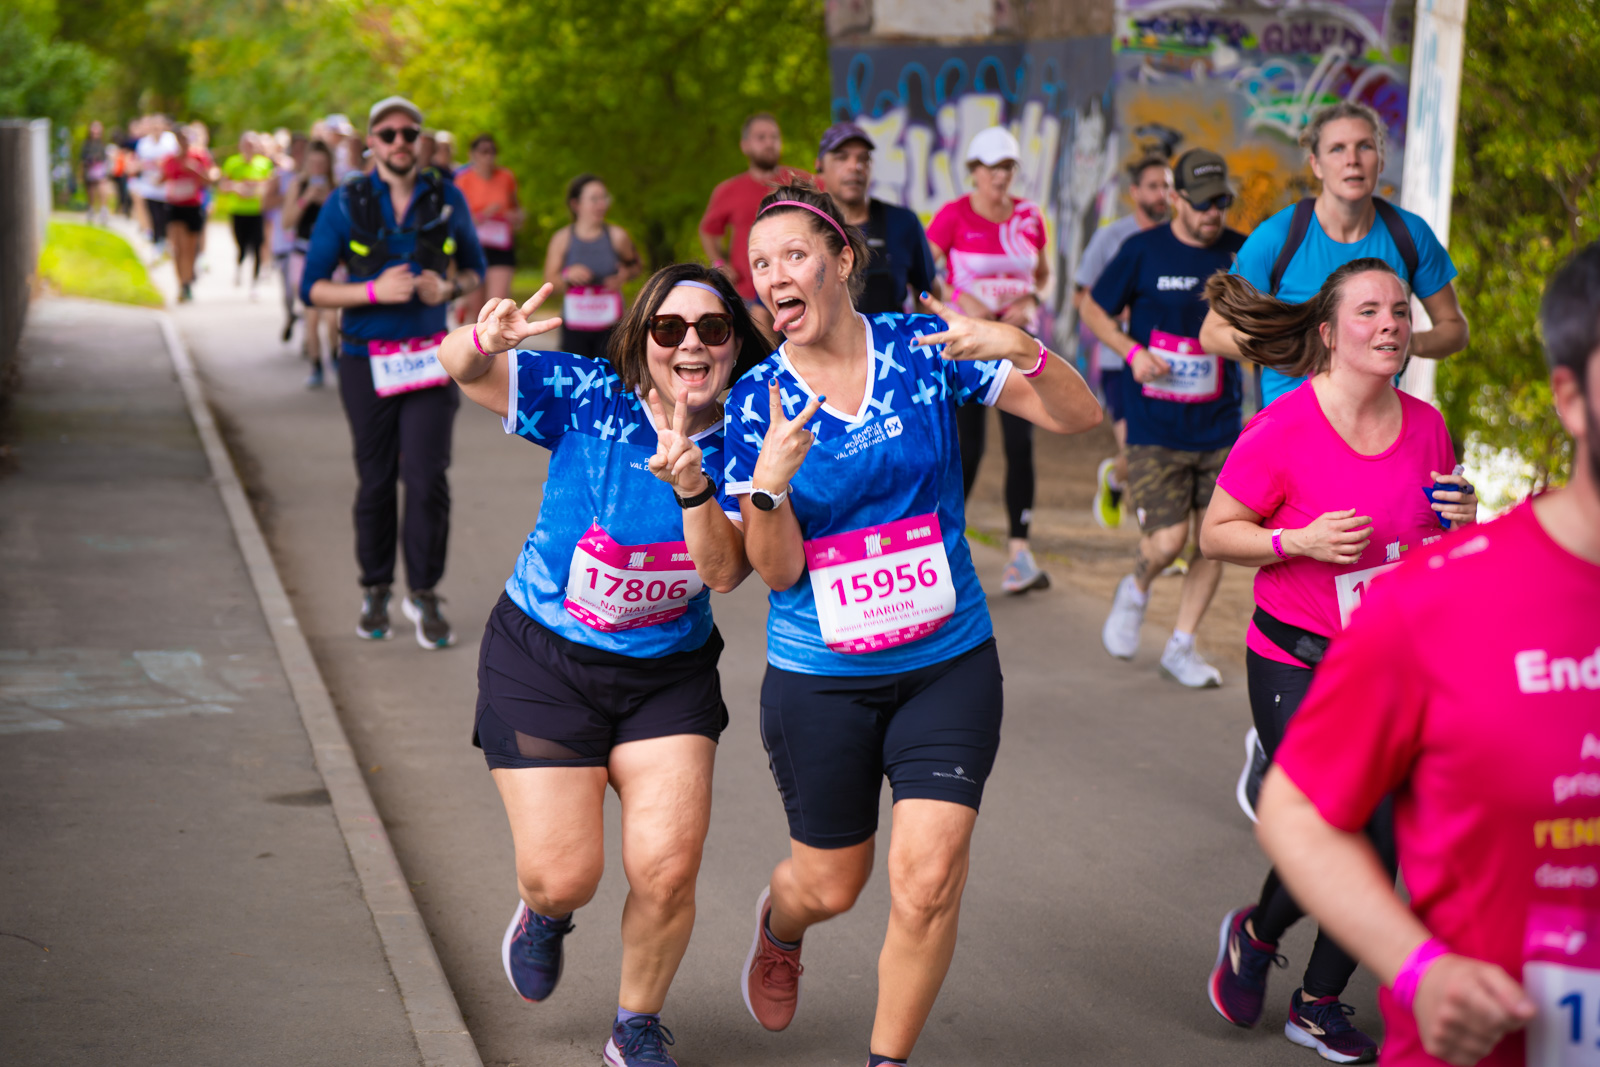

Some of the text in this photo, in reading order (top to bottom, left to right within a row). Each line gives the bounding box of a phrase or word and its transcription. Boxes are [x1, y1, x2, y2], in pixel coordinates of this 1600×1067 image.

[844, 428, 884, 450] POPULAIRE
[852, 422, 880, 441] BANQUE
[834, 433, 887, 461] VAL DE FRANCE
[629, 461, 643, 471] VAL
[863, 532, 882, 556] 10K
[1386, 540, 1400, 562] 10K
[628, 551, 647, 568] 10K
[585, 567, 688, 602] 17806
[830, 557, 938, 607] 15956
[600, 599, 658, 614] NATHALIE
[863, 599, 915, 619] MARION
[835, 623, 862, 633] BANQUE
[863, 616, 898, 628] POPULAIRE
[899, 612, 911, 620] VAL
[921, 604, 944, 615] FRANCE
[1557, 992, 1600, 1050] 1
